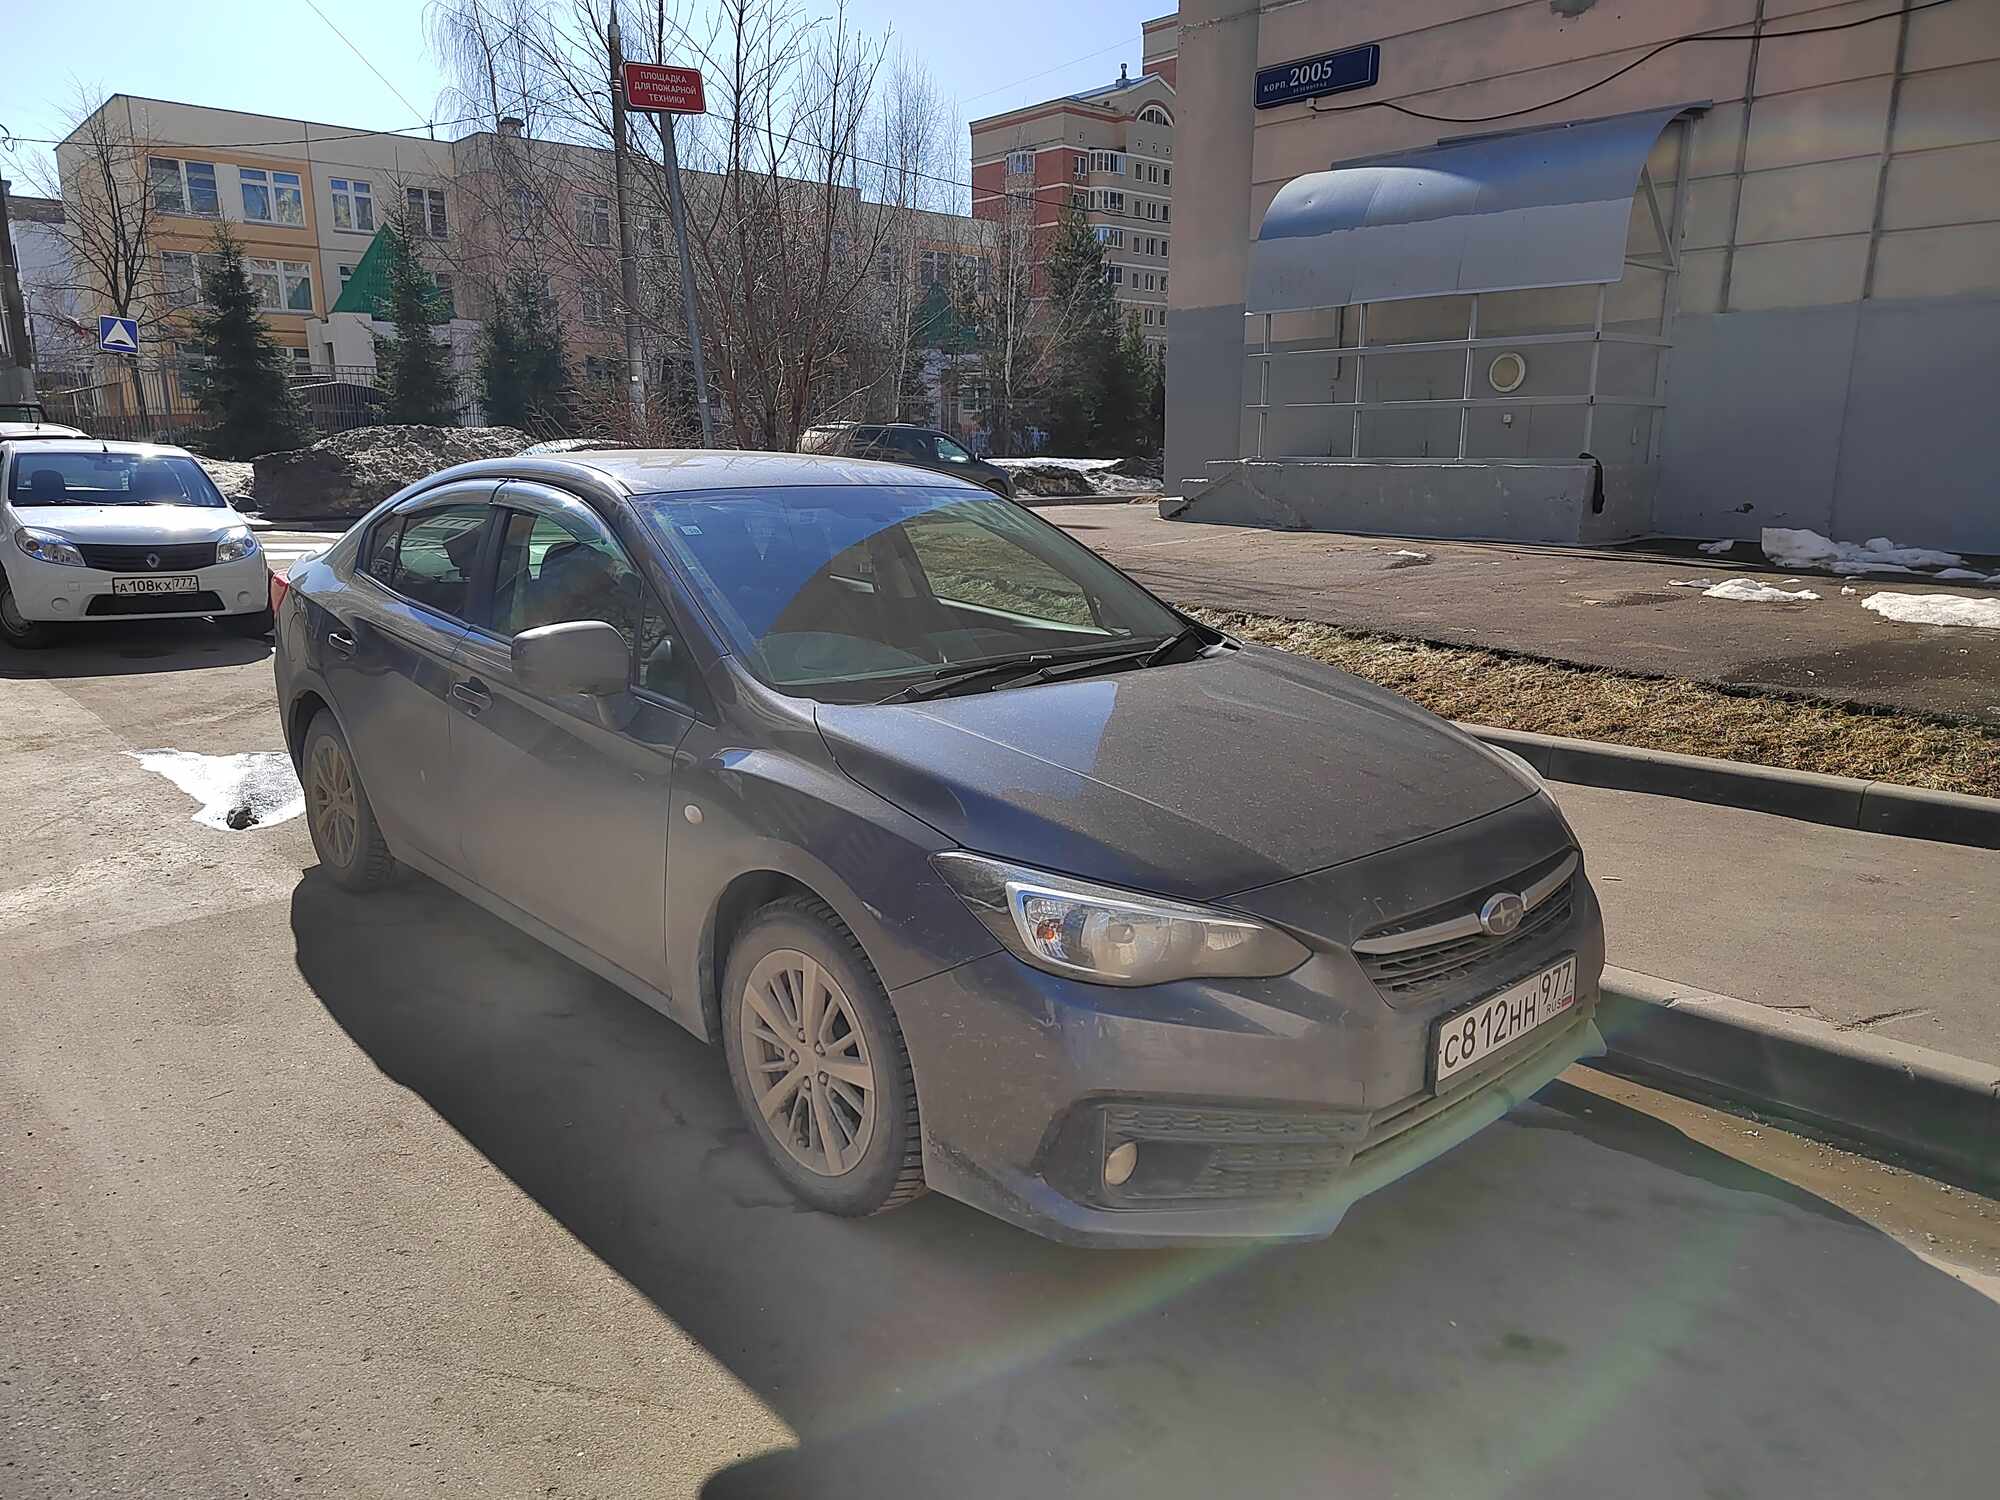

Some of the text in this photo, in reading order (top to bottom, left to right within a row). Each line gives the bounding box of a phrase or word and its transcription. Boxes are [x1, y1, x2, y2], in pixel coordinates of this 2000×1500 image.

[640, 71, 687, 84] ПЛОЩАДКА
[1289, 60, 1333, 87] 2005
[634, 81, 697, 95] ДЛЯ ПОЖАРНОЙ
[648, 93, 686, 105] ТЕХНИКИ
[174, 578, 194, 588] 777
[1541, 960, 1572, 1005] 977
[1546, 998, 1562, 1015] RUS
